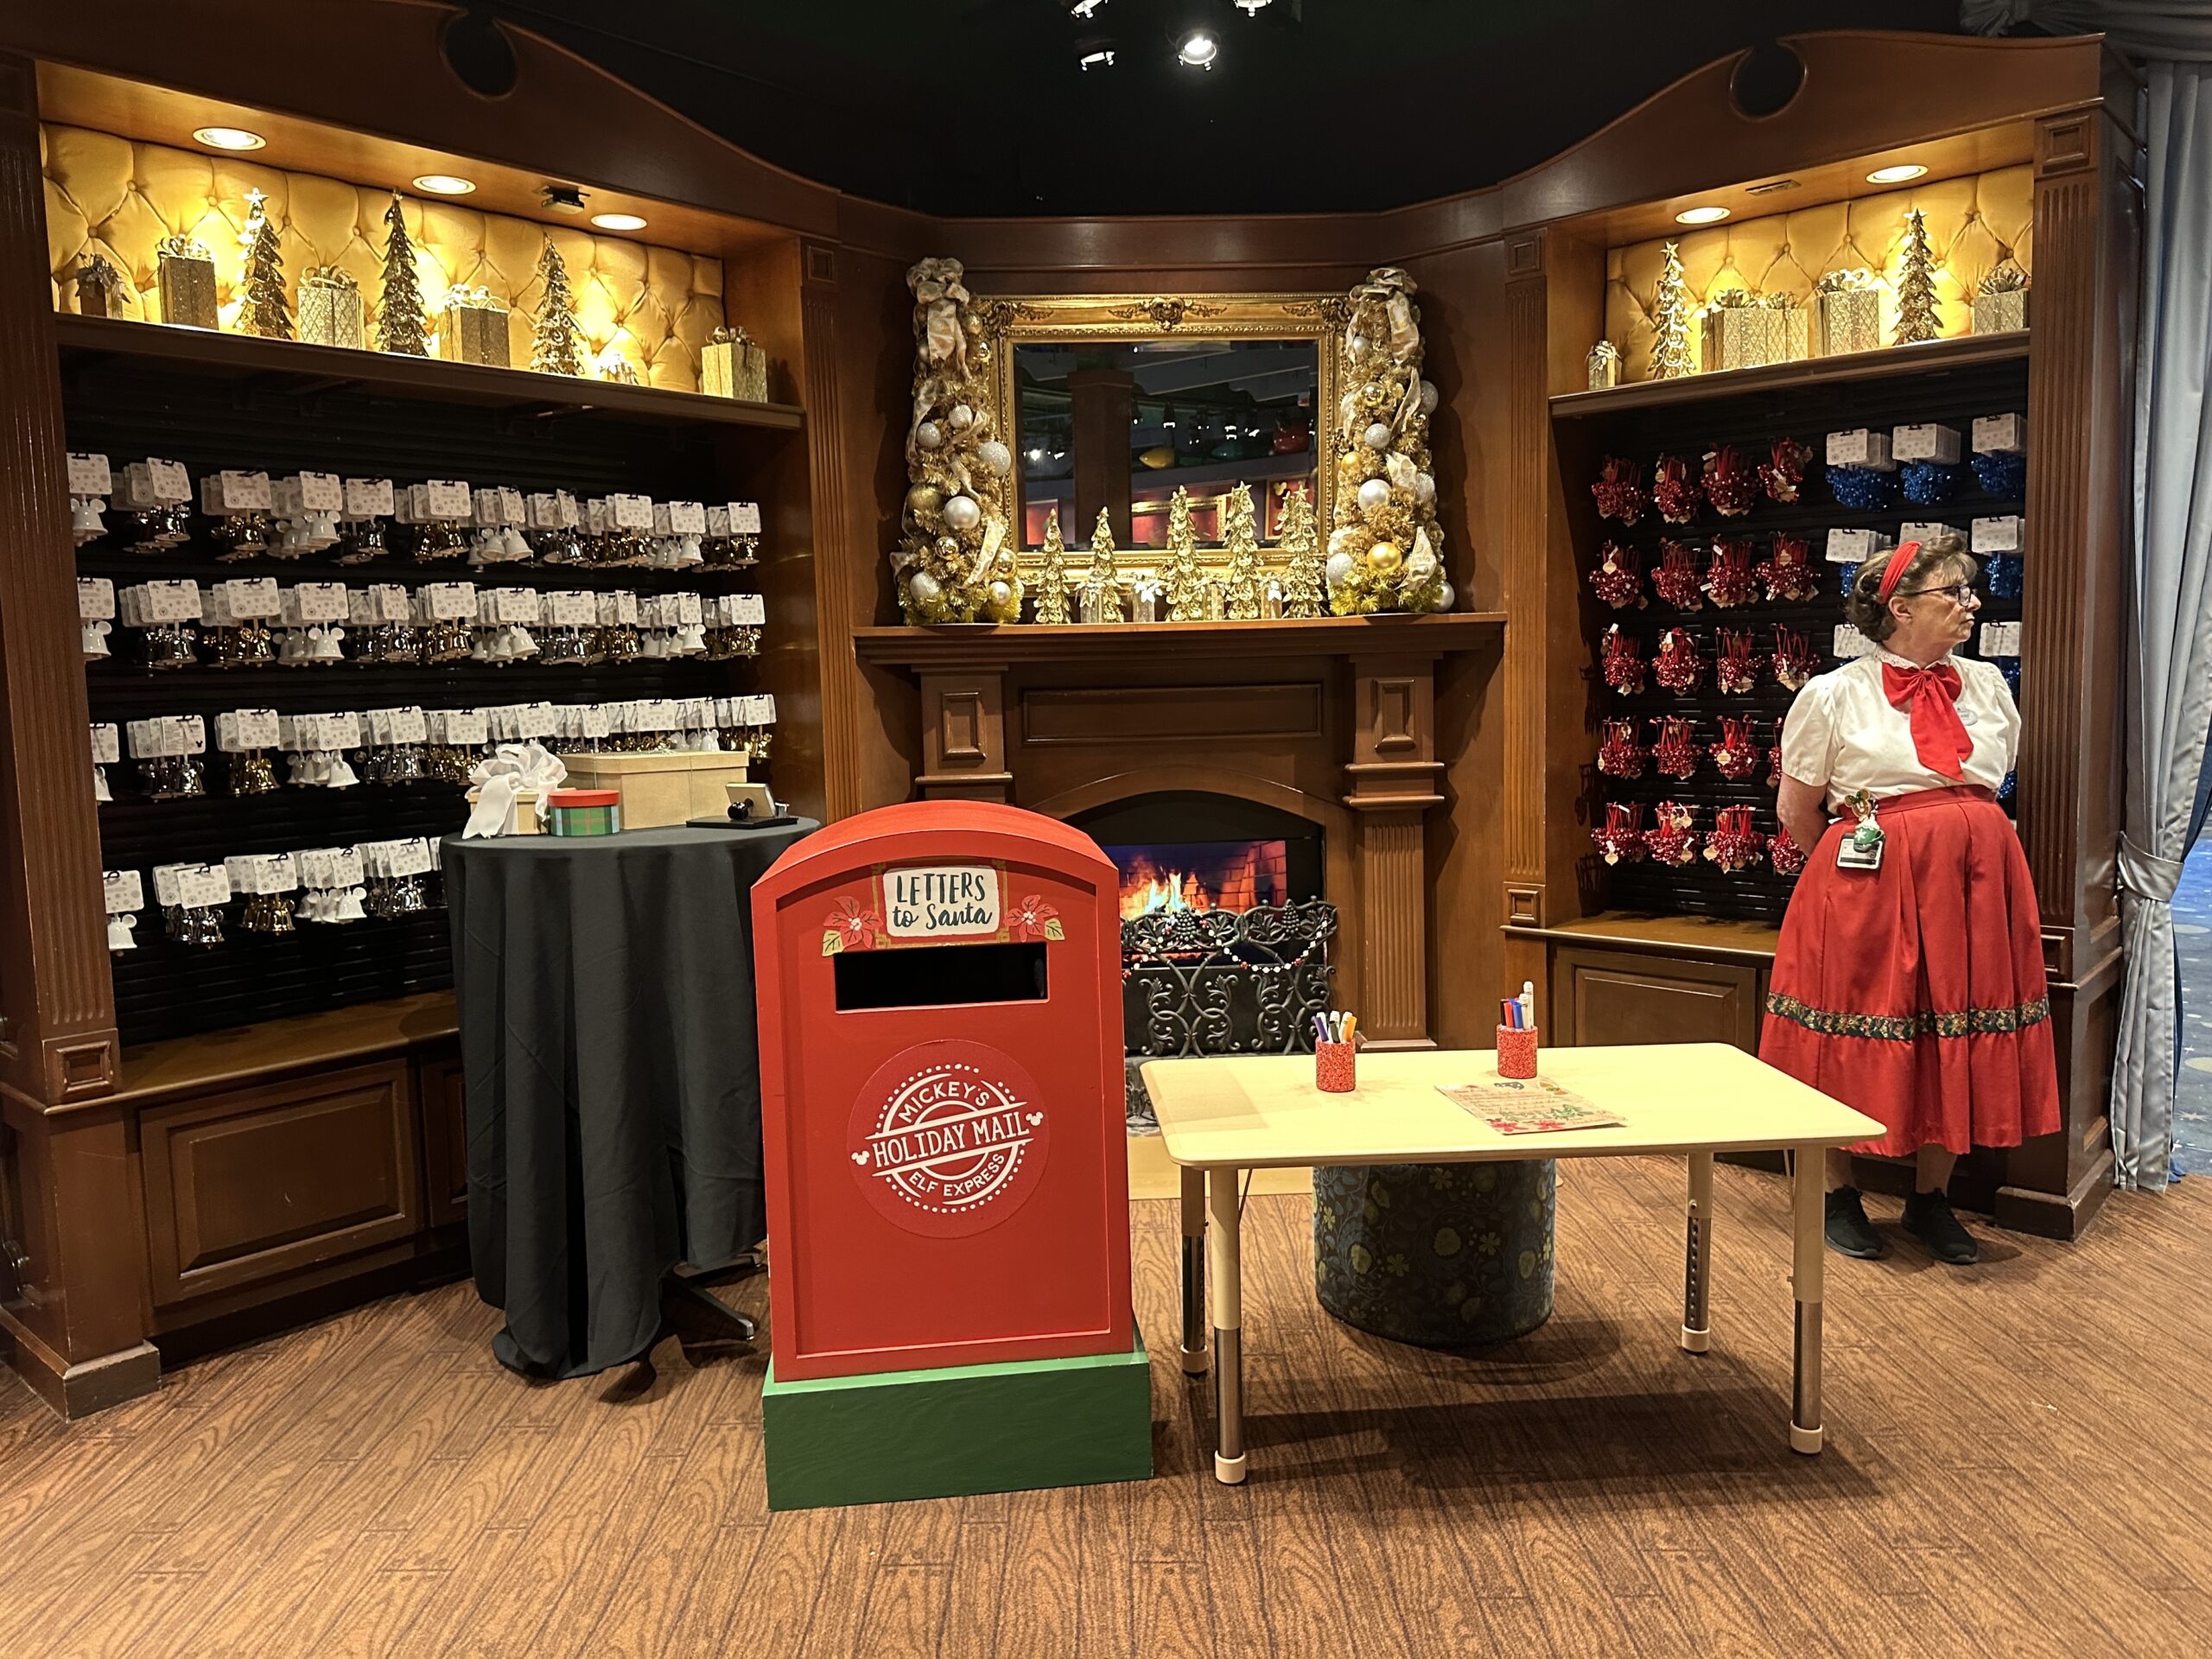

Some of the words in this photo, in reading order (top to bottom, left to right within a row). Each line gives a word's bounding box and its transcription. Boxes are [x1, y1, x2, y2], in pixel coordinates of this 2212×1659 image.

[896, 872, 986, 906] LETTERS
[893, 906, 918, 928] to
[925, 902, 993, 931] Santa
[898, 1081, 990, 1123] MICKEY'S
[872, 1123, 965, 1168] HOLIDAY
[971, 1111, 1030, 1145] MAIL
[908, 1171, 938, 1194] ELF
[943, 1154, 1005, 1197] EXPRESS
